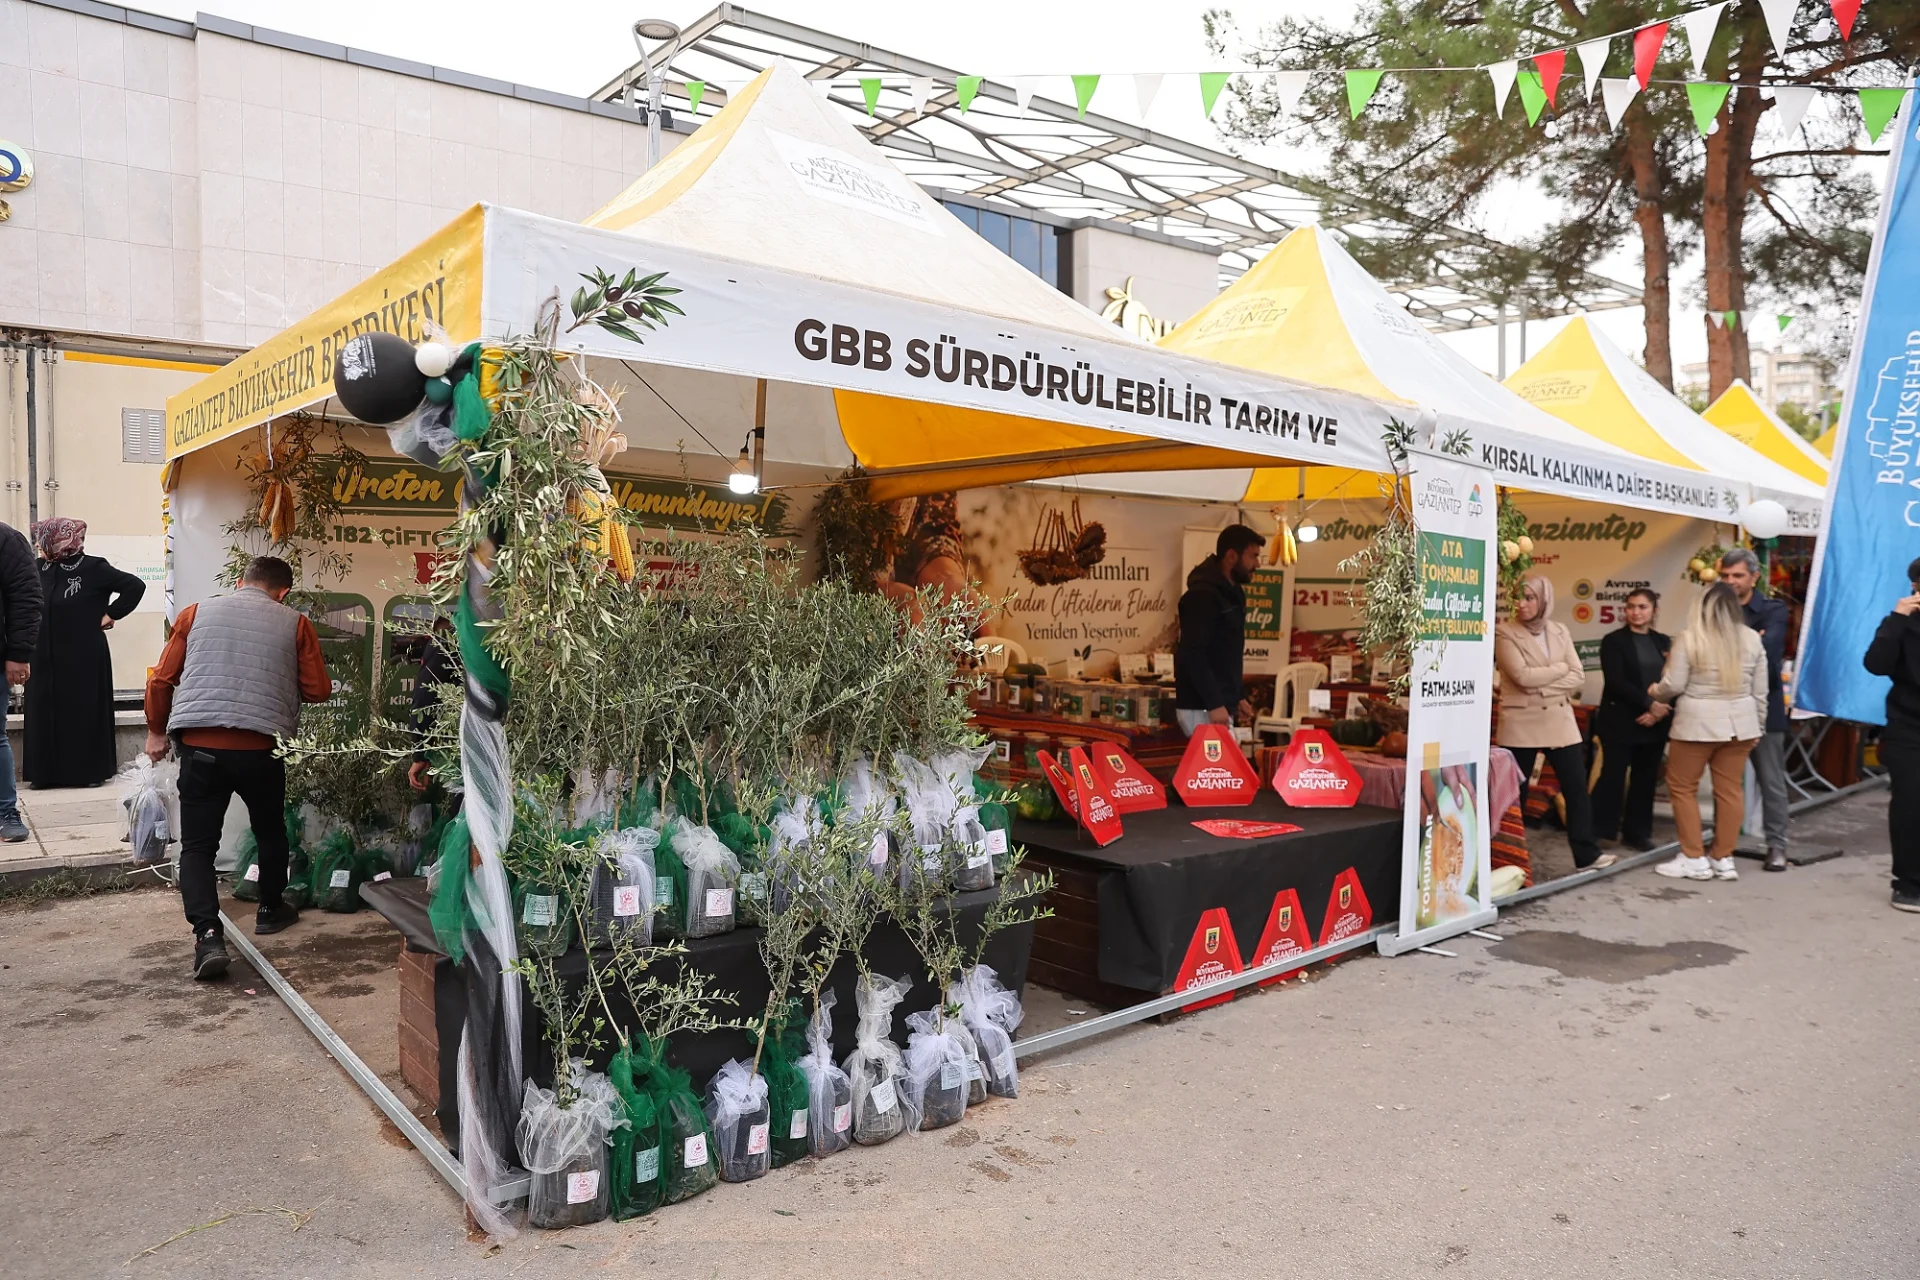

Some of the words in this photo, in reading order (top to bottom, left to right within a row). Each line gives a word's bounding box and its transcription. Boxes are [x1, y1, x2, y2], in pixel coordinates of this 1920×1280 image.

[173, 397, 226, 447] GAZİANTEP
[227, 335, 316, 423] BÜYÜKŞEHİR
[794, 318, 892, 372] GBB
[904, 334, 1212, 426] SÜRDÜRÜLEBİLİR
[1219, 397, 1301, 441] TARIM
[1307, 414, 1339, 447] VE
[1482, 443, 1539, 477] KIRSAL
[1542, 457, 1614, 492] KALKINMA
[1616, 471, 1654, 500] DAİRE
[1656, 481, 1719, 509] BAŞKANLIĞI
[1441, 539, 1464, 559] ATA
[1524, 512, 1647, 551] aziantep
[1605, 579, 1651, 590] Avrupa
[1051, 586, 1125, 622] Çiftçilerin
[1126, 587, 1168, 620] Elinde
[1600, 605, 1615, 624] 5
[1026, 621, 1078, 640] Yeniden
[1081, 621, 1141, 644] Yeşeriyor.
[1421, 680, 1451, 698] FATMA
[1420, 813, 1435, 918] TOHUMLAR
